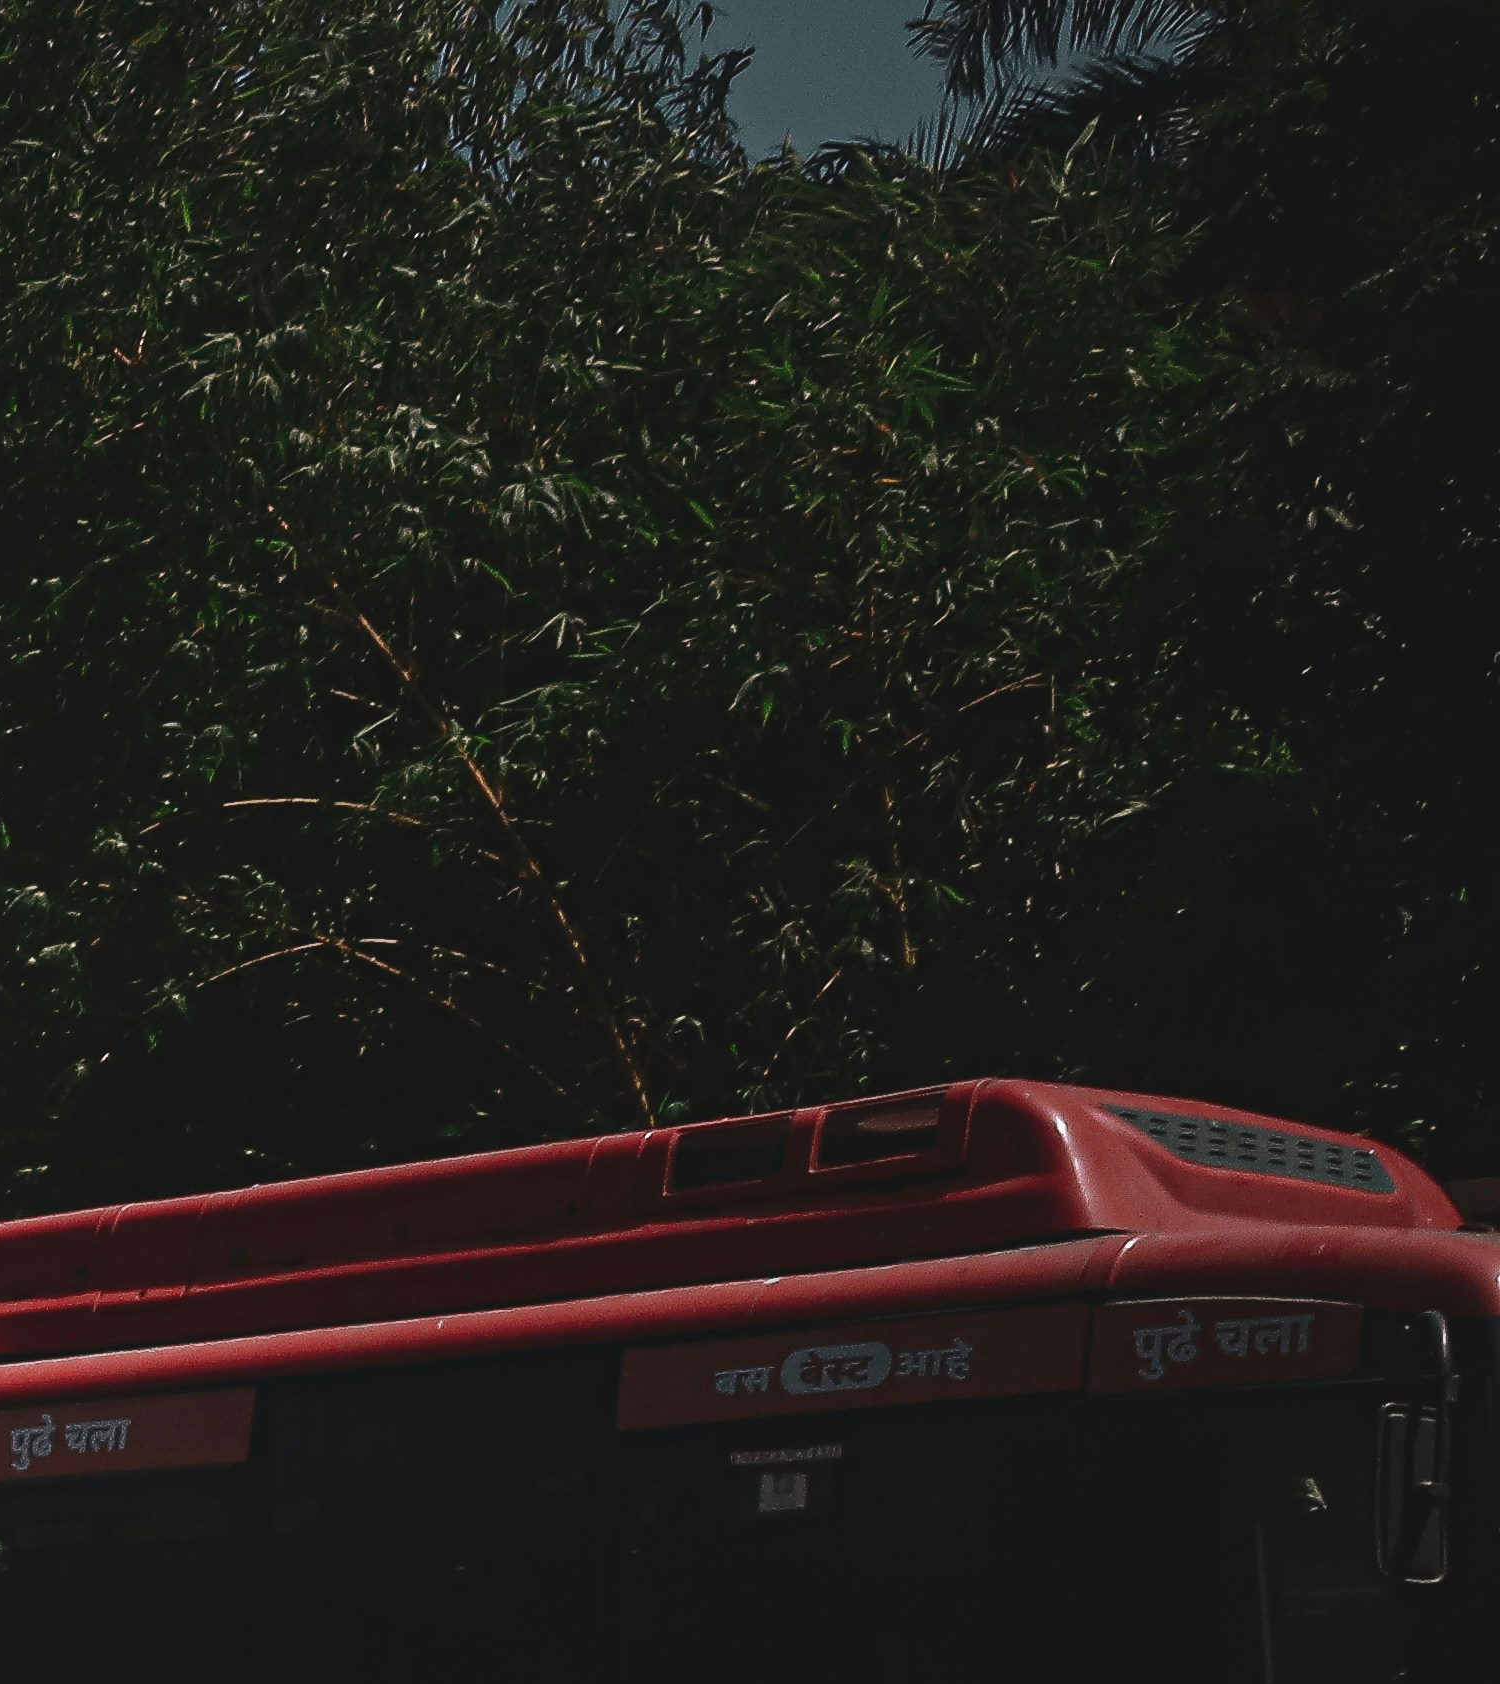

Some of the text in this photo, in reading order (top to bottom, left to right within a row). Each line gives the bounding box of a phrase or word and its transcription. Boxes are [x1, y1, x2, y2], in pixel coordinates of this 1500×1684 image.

[715, 1337, 973, 1395] बस बेस्ट आहे
[1133, 1310, 1315, 1380] पुढे चला
[10, 1413, 133, 1472] पुढे चला
